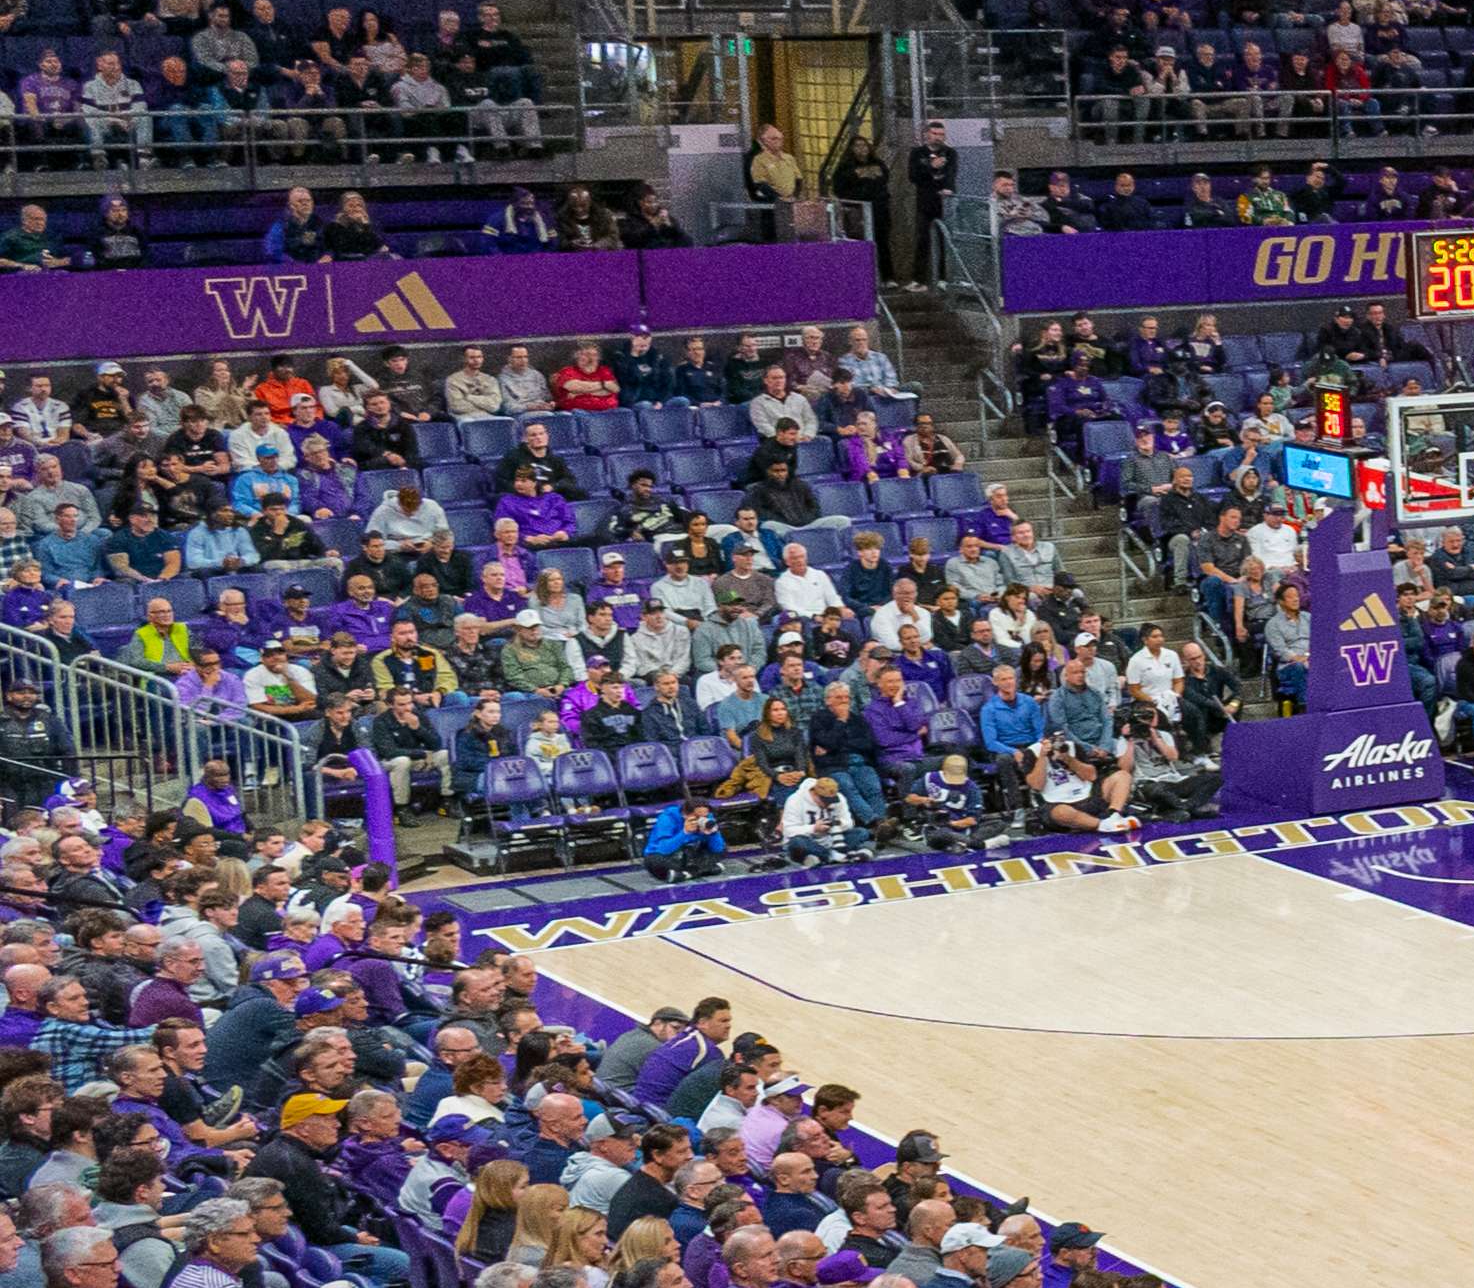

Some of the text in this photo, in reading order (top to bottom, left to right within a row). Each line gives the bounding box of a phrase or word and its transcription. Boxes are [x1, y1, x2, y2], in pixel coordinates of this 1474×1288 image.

[1253, 235, 1334, 286] GO
[205, 274, 306, 338] W
[1341, 641, 1397, 687] W
[1323, 731, 1432, 772] Alaska
[1332, 767, 1424, 789] AIRLINES
